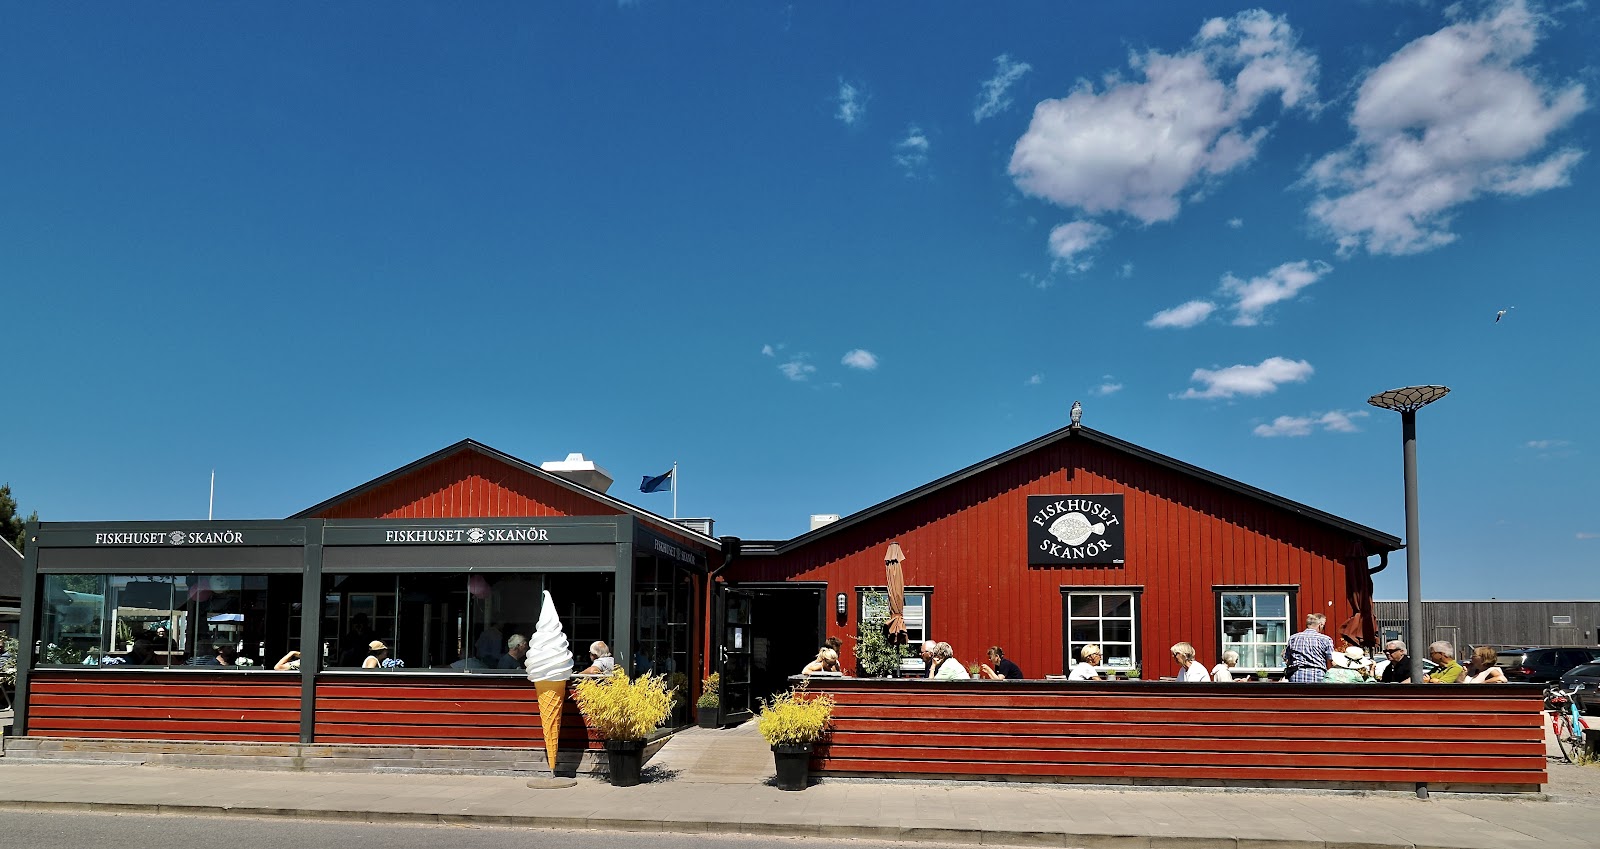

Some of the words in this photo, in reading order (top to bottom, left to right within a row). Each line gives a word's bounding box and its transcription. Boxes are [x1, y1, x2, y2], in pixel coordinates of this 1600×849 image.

[1032, 499, 1120, 527] FISKHUSET
[95, 532, 167, 544] FISKHUSET
[188, 530, 244, 544] SKANÖR
[385, 529, 464, 542] FISKHUSET
[487, 527, 549, 541] SKANÖR
[1039, 539, 1113, 559] SKANÖR
